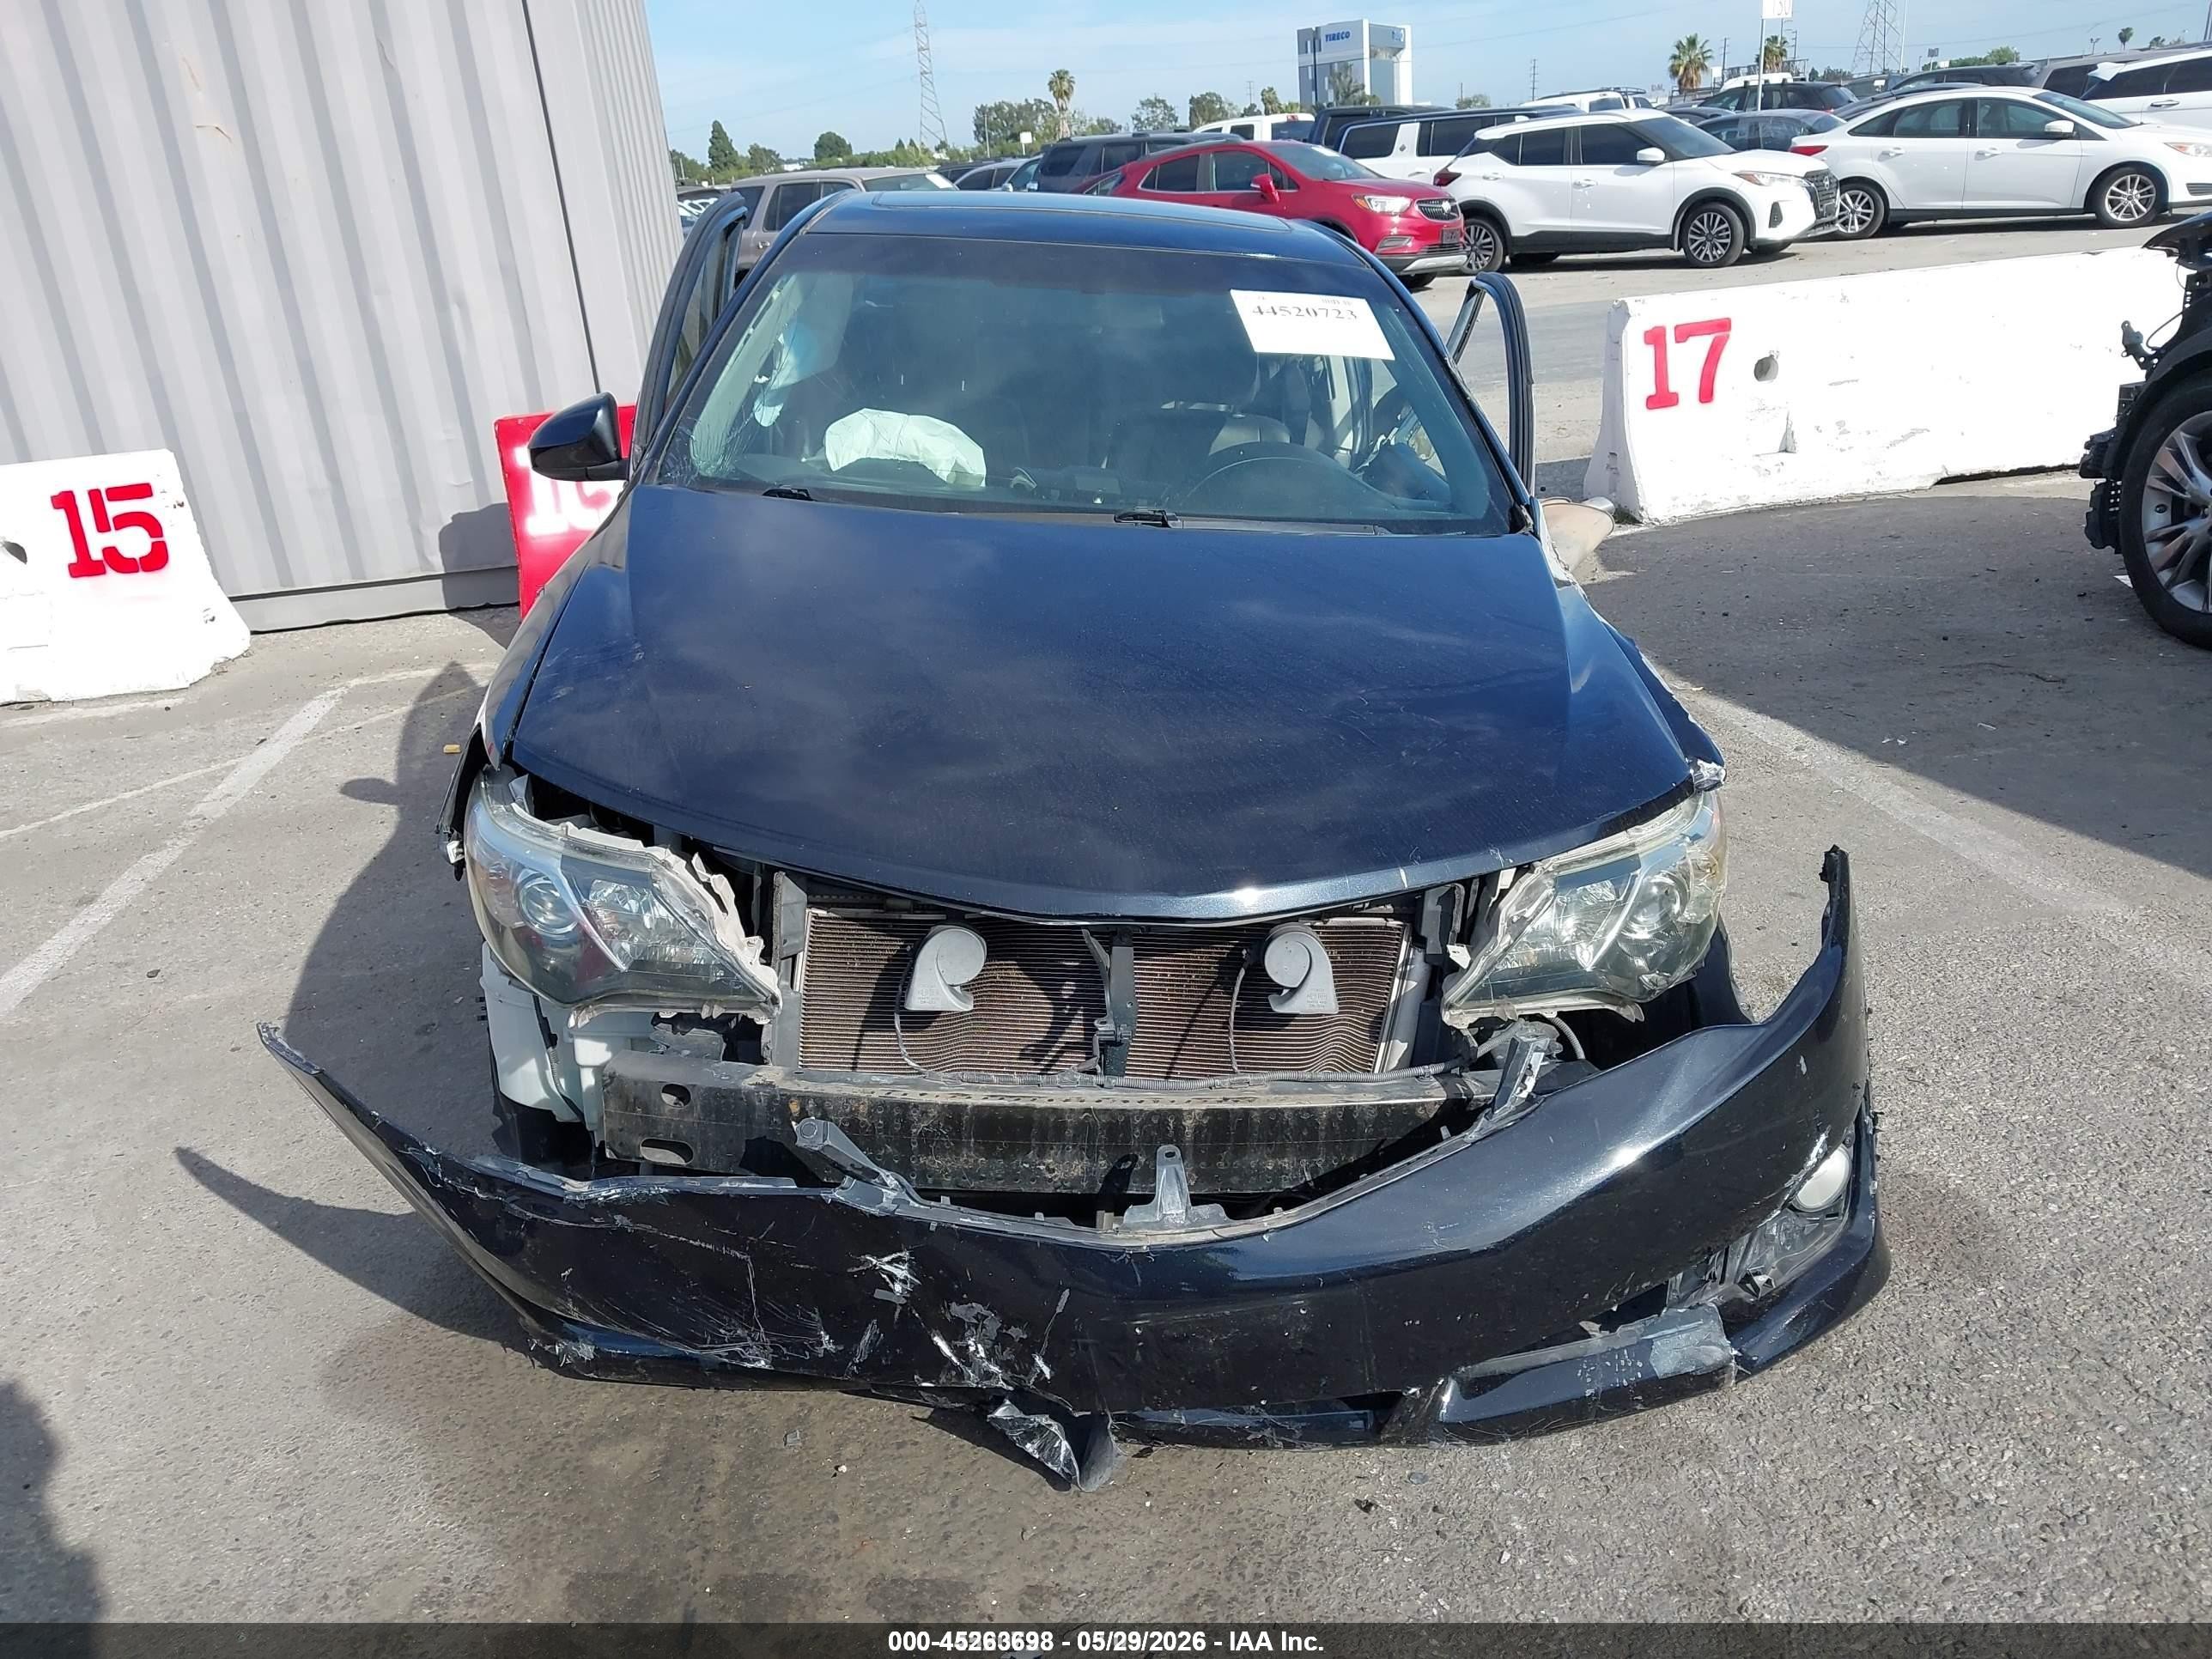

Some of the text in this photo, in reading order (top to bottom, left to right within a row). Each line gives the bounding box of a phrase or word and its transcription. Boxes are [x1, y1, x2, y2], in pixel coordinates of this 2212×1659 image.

[1324, 30, 1351, 42] TIRECO
[1252, 305, 1358, 320] 44520723
[1644, 318, 1732, 410] 17
[51, 483, 169, 579] 15
